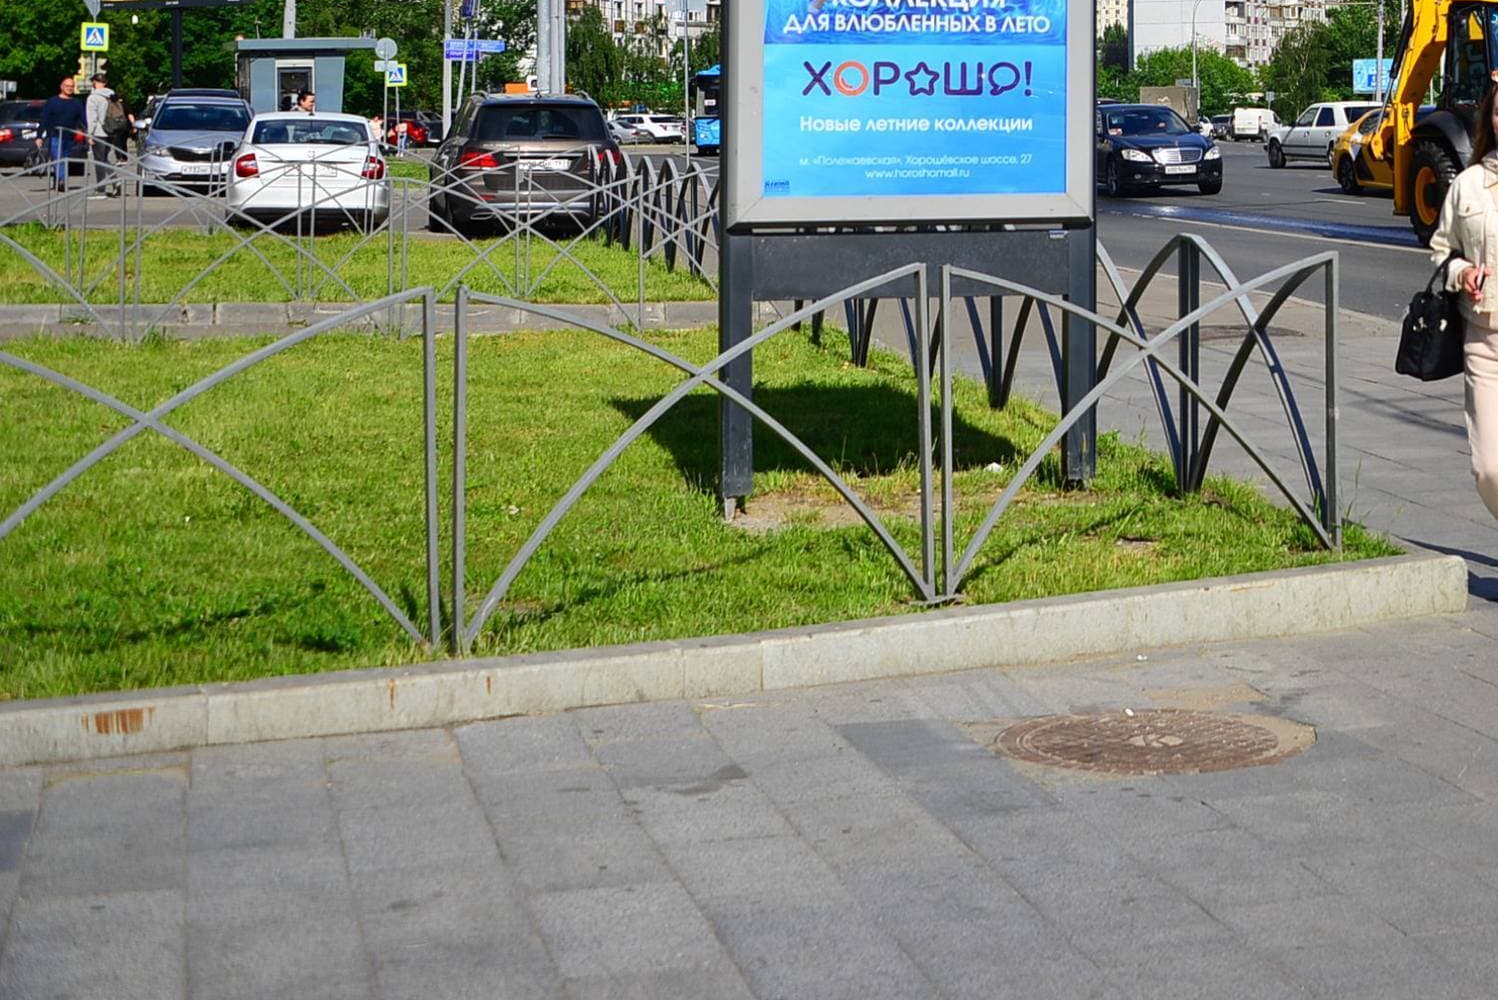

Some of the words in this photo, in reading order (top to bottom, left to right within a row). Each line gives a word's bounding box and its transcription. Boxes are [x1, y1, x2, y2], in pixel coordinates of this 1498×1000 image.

[783, 14, 829, 34] ДЛЯ
[835, 14, 980, 32] ВЛЮБЛЕННЫХ
[985, 15, 996, 32] В
[1000, 15, 1050, 33] ЛЕТО
[800, 116, 861, 131] Новые
[866, 118, 930, 131] летние
[934, 118, 1033, 133] коллекции
[1020, 153, 1033, 164] 27
